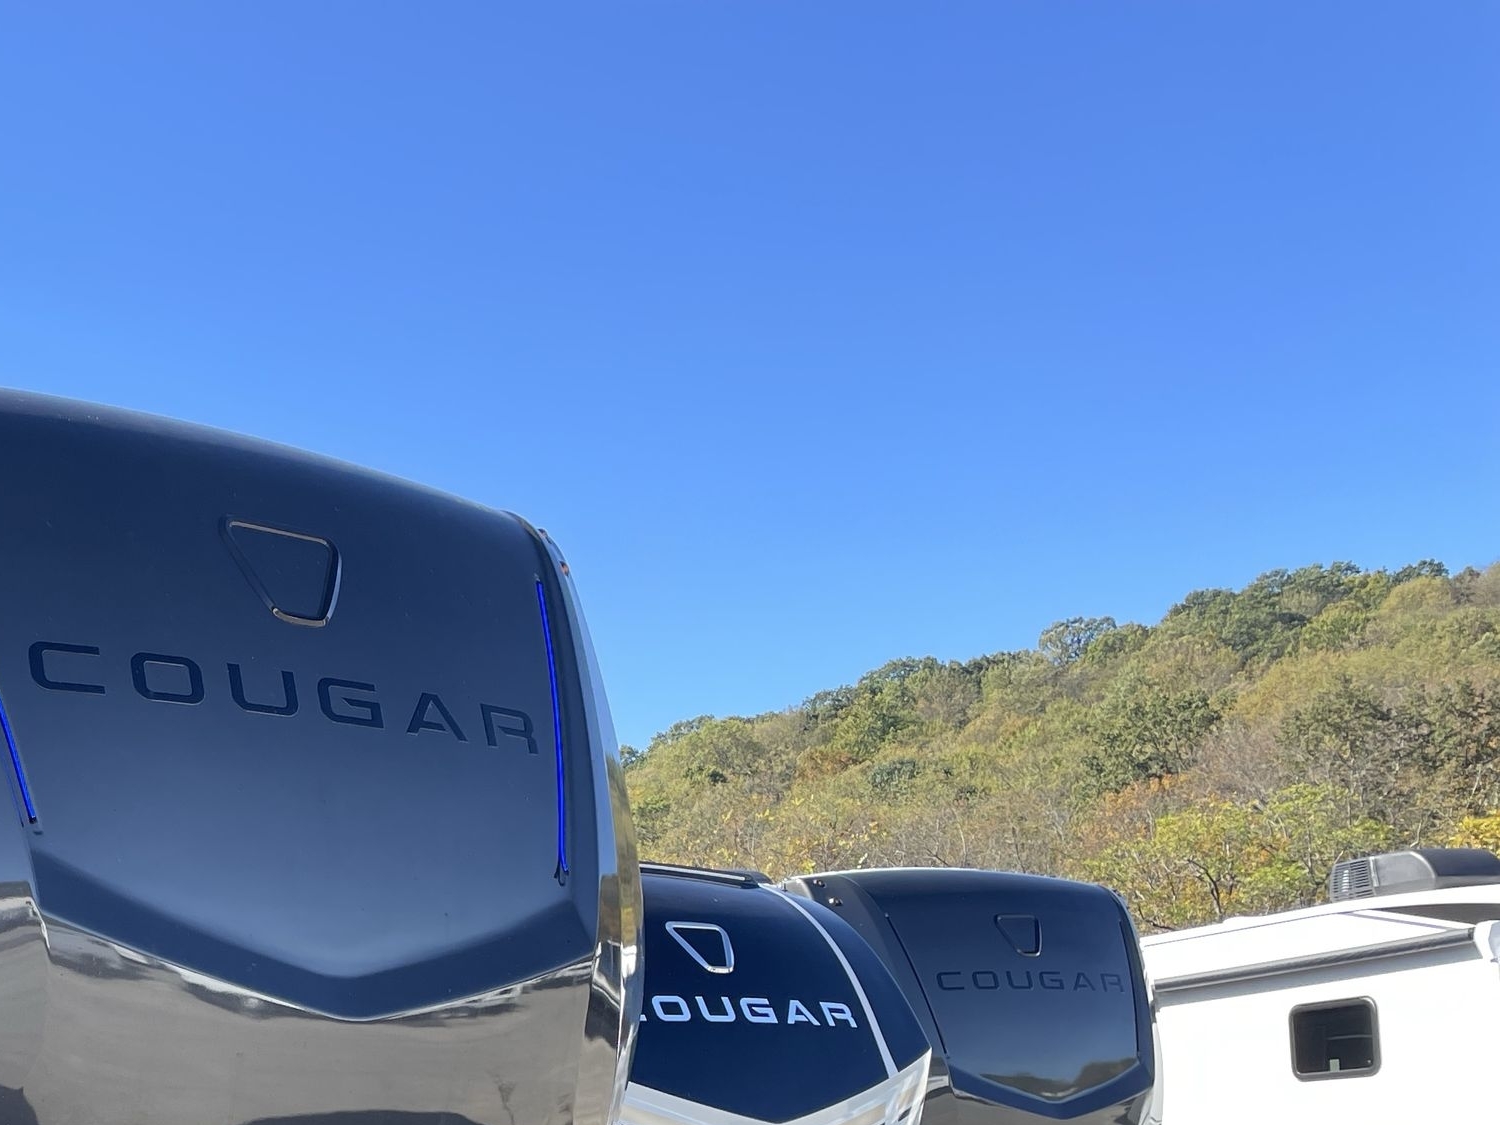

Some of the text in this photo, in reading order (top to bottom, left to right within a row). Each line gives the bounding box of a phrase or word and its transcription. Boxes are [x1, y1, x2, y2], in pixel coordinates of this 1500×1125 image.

[28, 640, 538, 755] COUGAR
[936, 970, 1126, 993] COUGAR
[639, 994, 858, 1029] OUGAR
